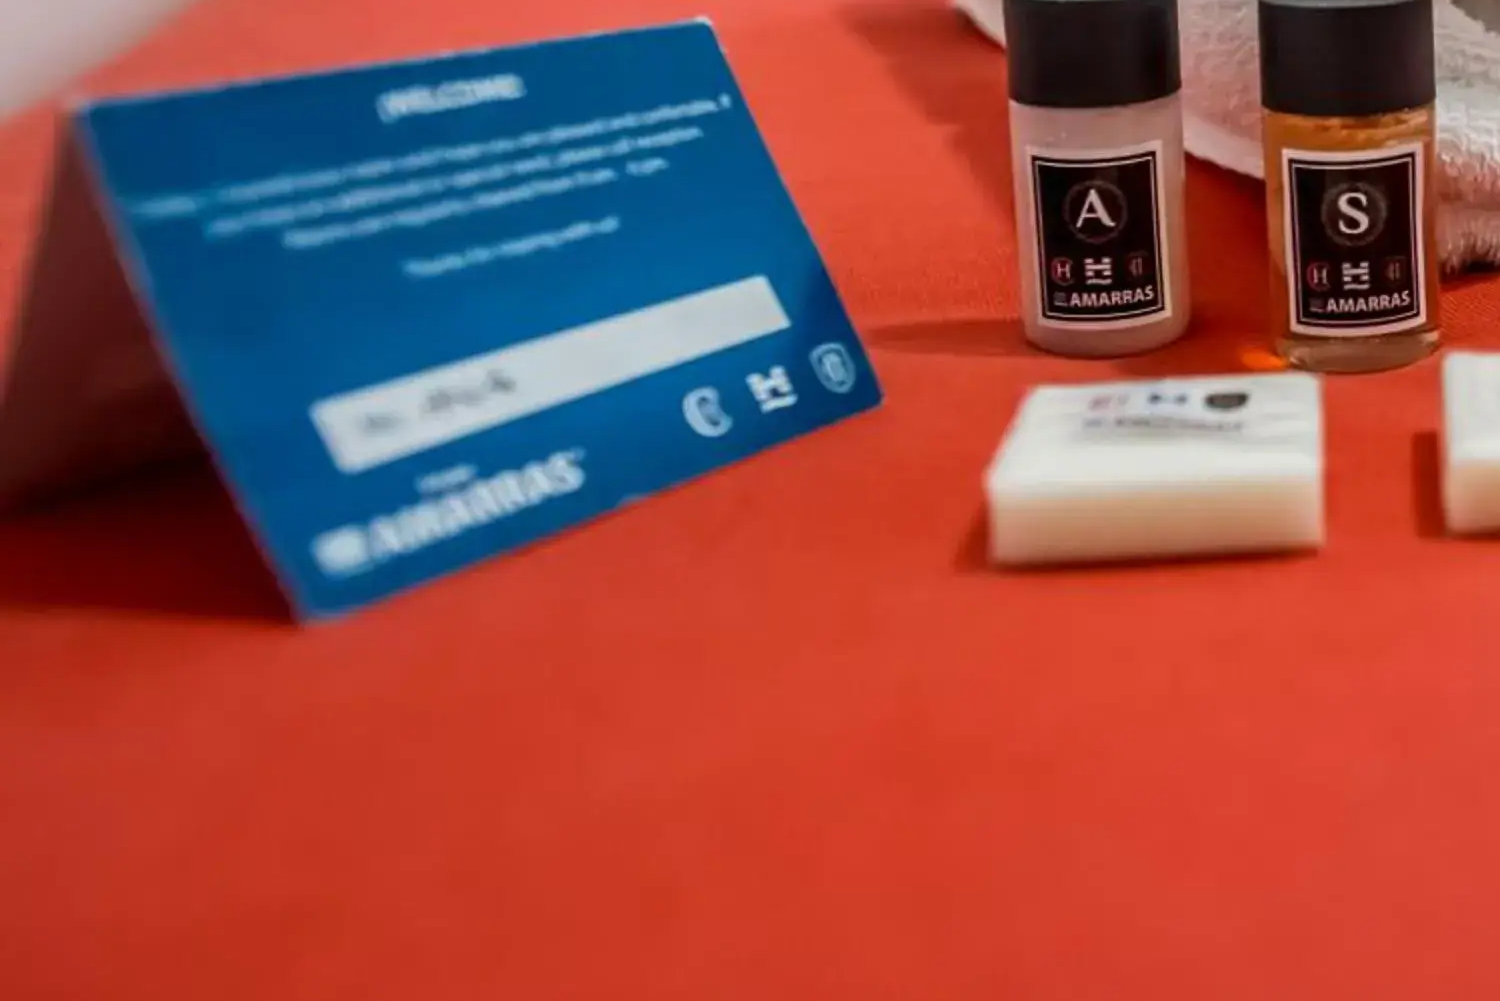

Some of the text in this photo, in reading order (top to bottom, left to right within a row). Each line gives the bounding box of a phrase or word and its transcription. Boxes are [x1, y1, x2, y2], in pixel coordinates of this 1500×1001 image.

[1075, 188, 1116, 228] A
[1337, 192, 1370, 234] S
[1069, 285, 1155, 308] AMARRAS
[1326, 290, 1411, 314] AMARRAS
